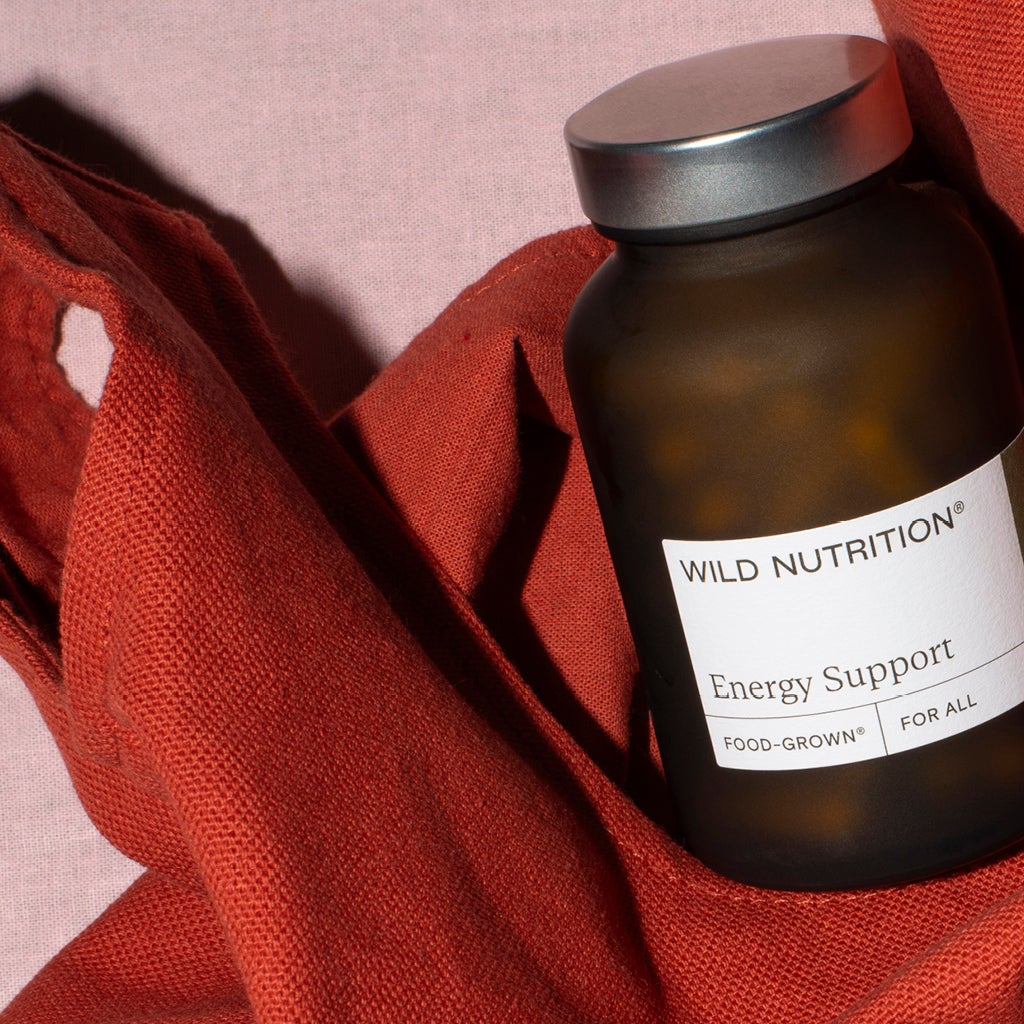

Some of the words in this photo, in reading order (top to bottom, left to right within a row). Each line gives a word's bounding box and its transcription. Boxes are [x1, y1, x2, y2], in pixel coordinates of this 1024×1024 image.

[680, 558, 760, 583] WILD
[708, 673, 814, 705] Energy
[824, 637, 955, 693] Support
[900, 708, 940, 731] FOR
[945, 693, 978, 717] ALL
